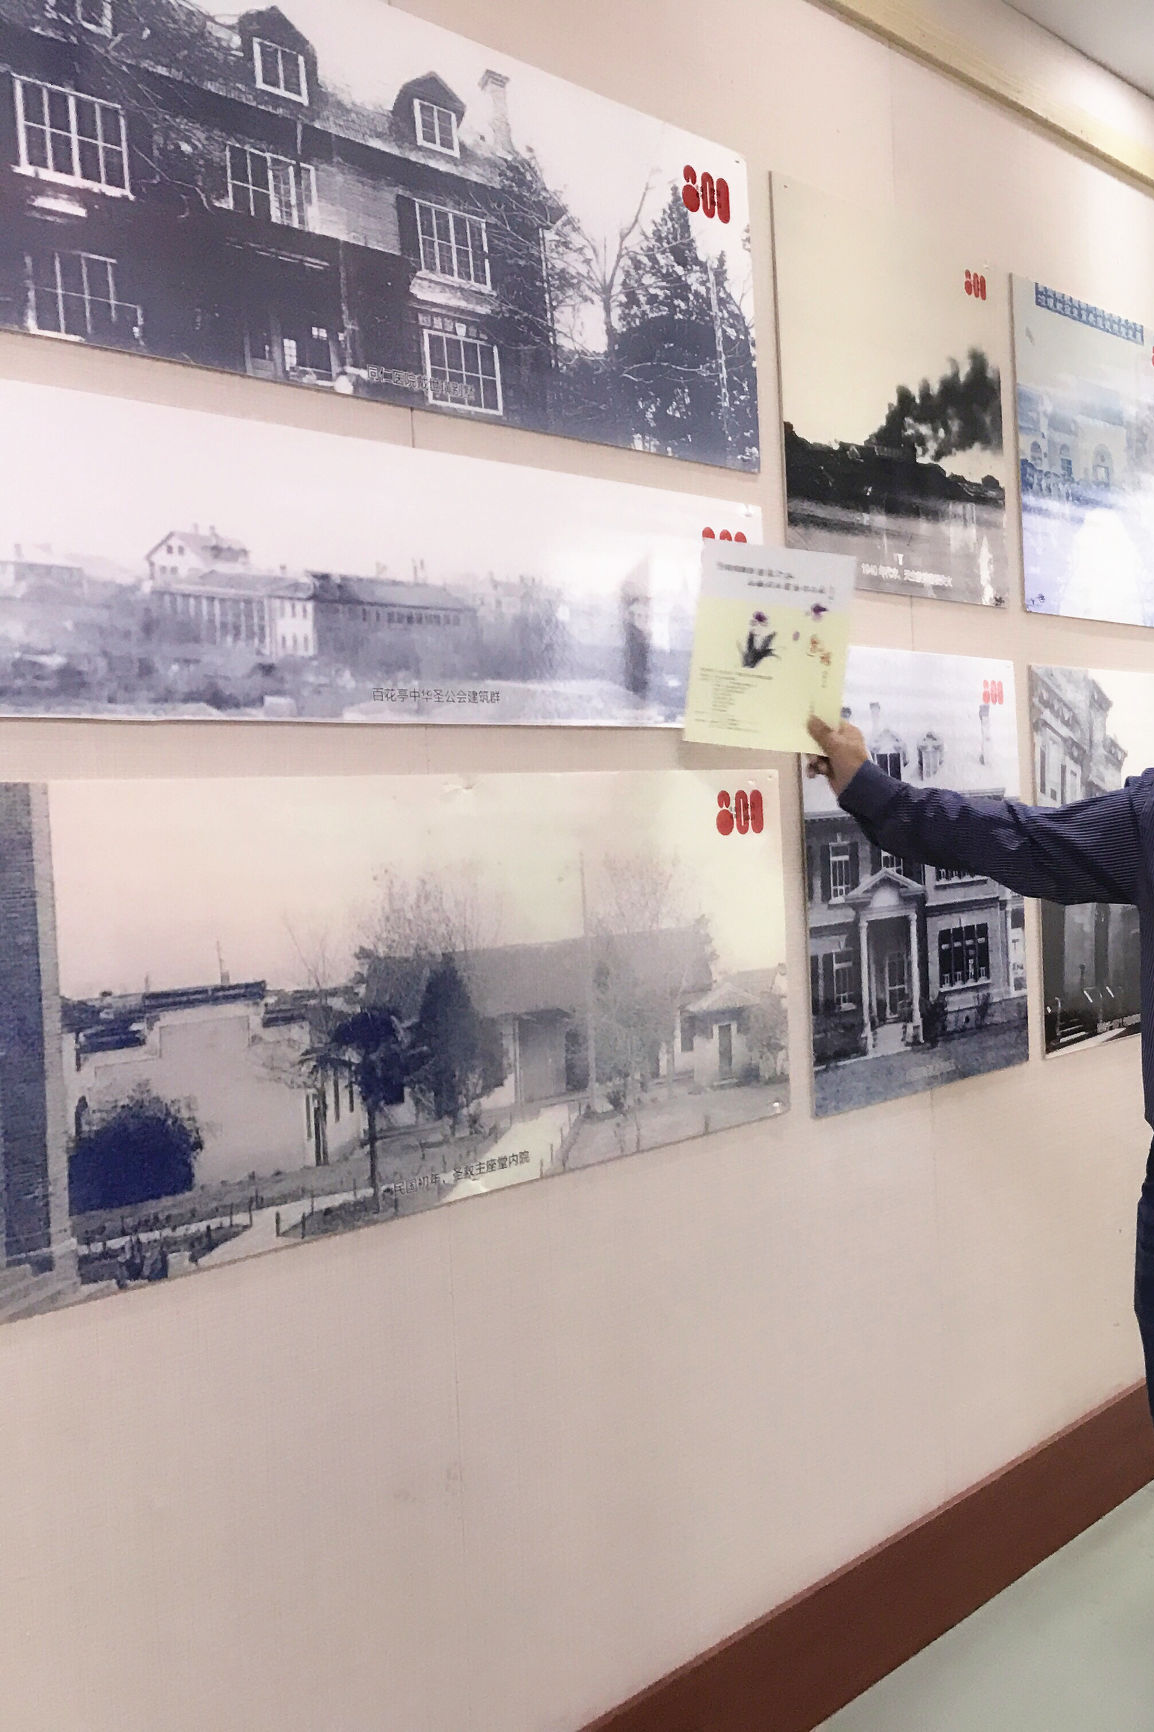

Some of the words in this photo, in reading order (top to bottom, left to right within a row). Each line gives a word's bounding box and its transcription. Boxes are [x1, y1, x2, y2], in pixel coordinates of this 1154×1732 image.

[372, 687, 501, 704] 百花亭中华圣公会建筑群
